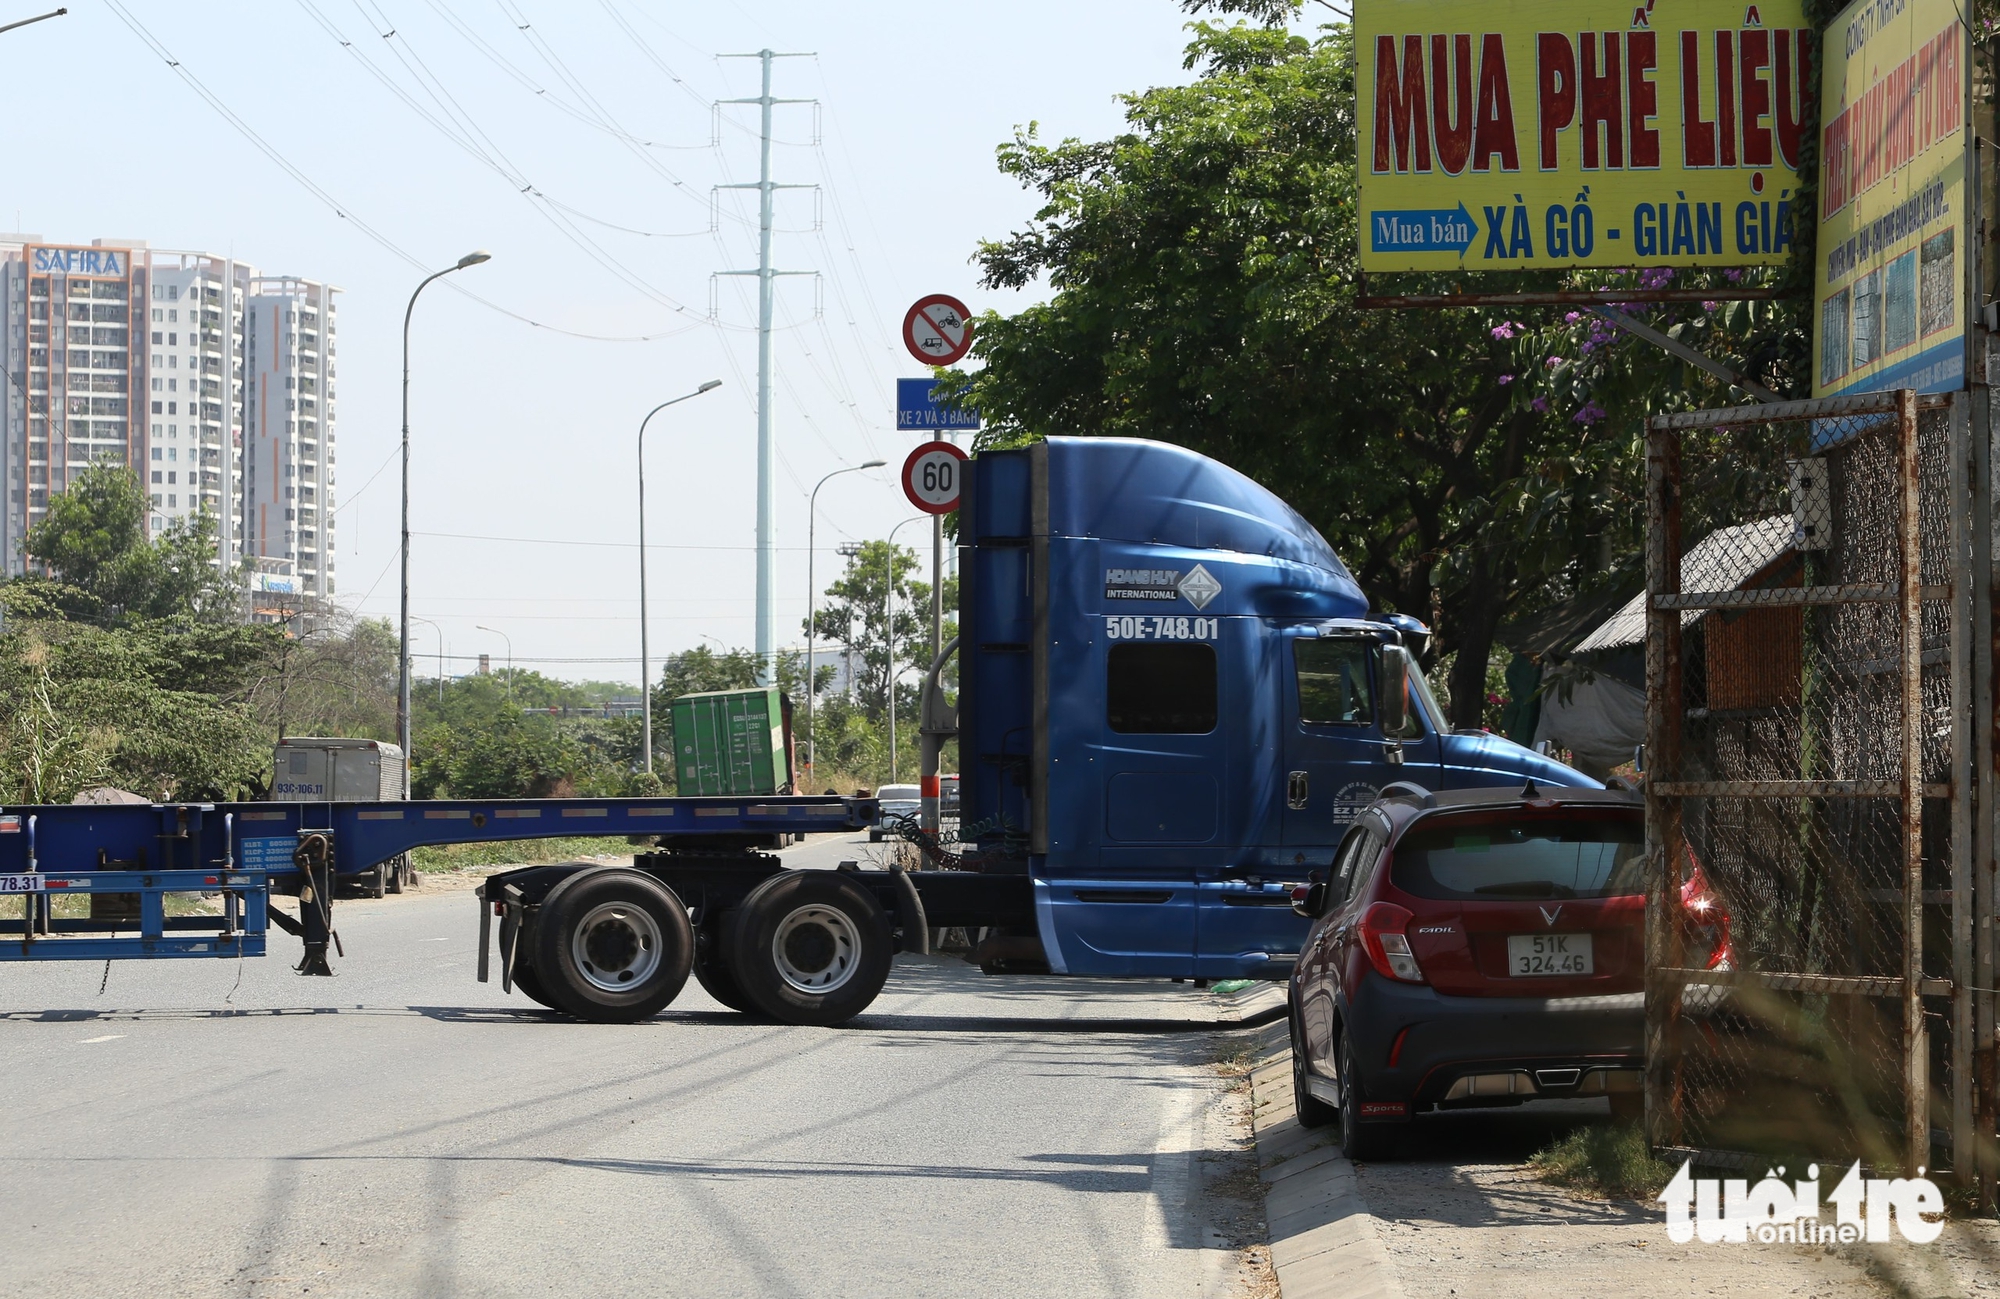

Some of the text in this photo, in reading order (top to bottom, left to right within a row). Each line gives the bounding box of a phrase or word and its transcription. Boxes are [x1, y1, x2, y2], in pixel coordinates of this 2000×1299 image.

[1935, 19, 1960, 145] NGA
[1371, 0, 1814, 195] MUA PHẾ LIỆU
[1377, 215, 1469, 245] Mua bán
[1483, 194, 1534, 259] XÀ
[1546, 185, 1594, 258] GỒ
[1634, 190, 1722, 257] GIÀN
[1736, 189, 1794, 254] GIÁ
[34, 248, 121, 275] SAFIRA
[899, 410, 913, 425] XE
[915, 410, 922, 425] 2
[924, 406, 938, 425] VÀ
[940, 410, 947, 425] 3
[922, 462, 953, 491] 60
[1107, 589, 1177, 599] INTERNATIONAL
[1106, 617, 1218, 640] 50E-748.01
[277, 783, 323, 794] 93C-106.11
[0, 876, 38, 890] 78.31
[1533, 936, 1568, 953] 51K
[1519, 955, 1585, 974] 324.46
[1362, 1105, 1404, 1113] Sports
